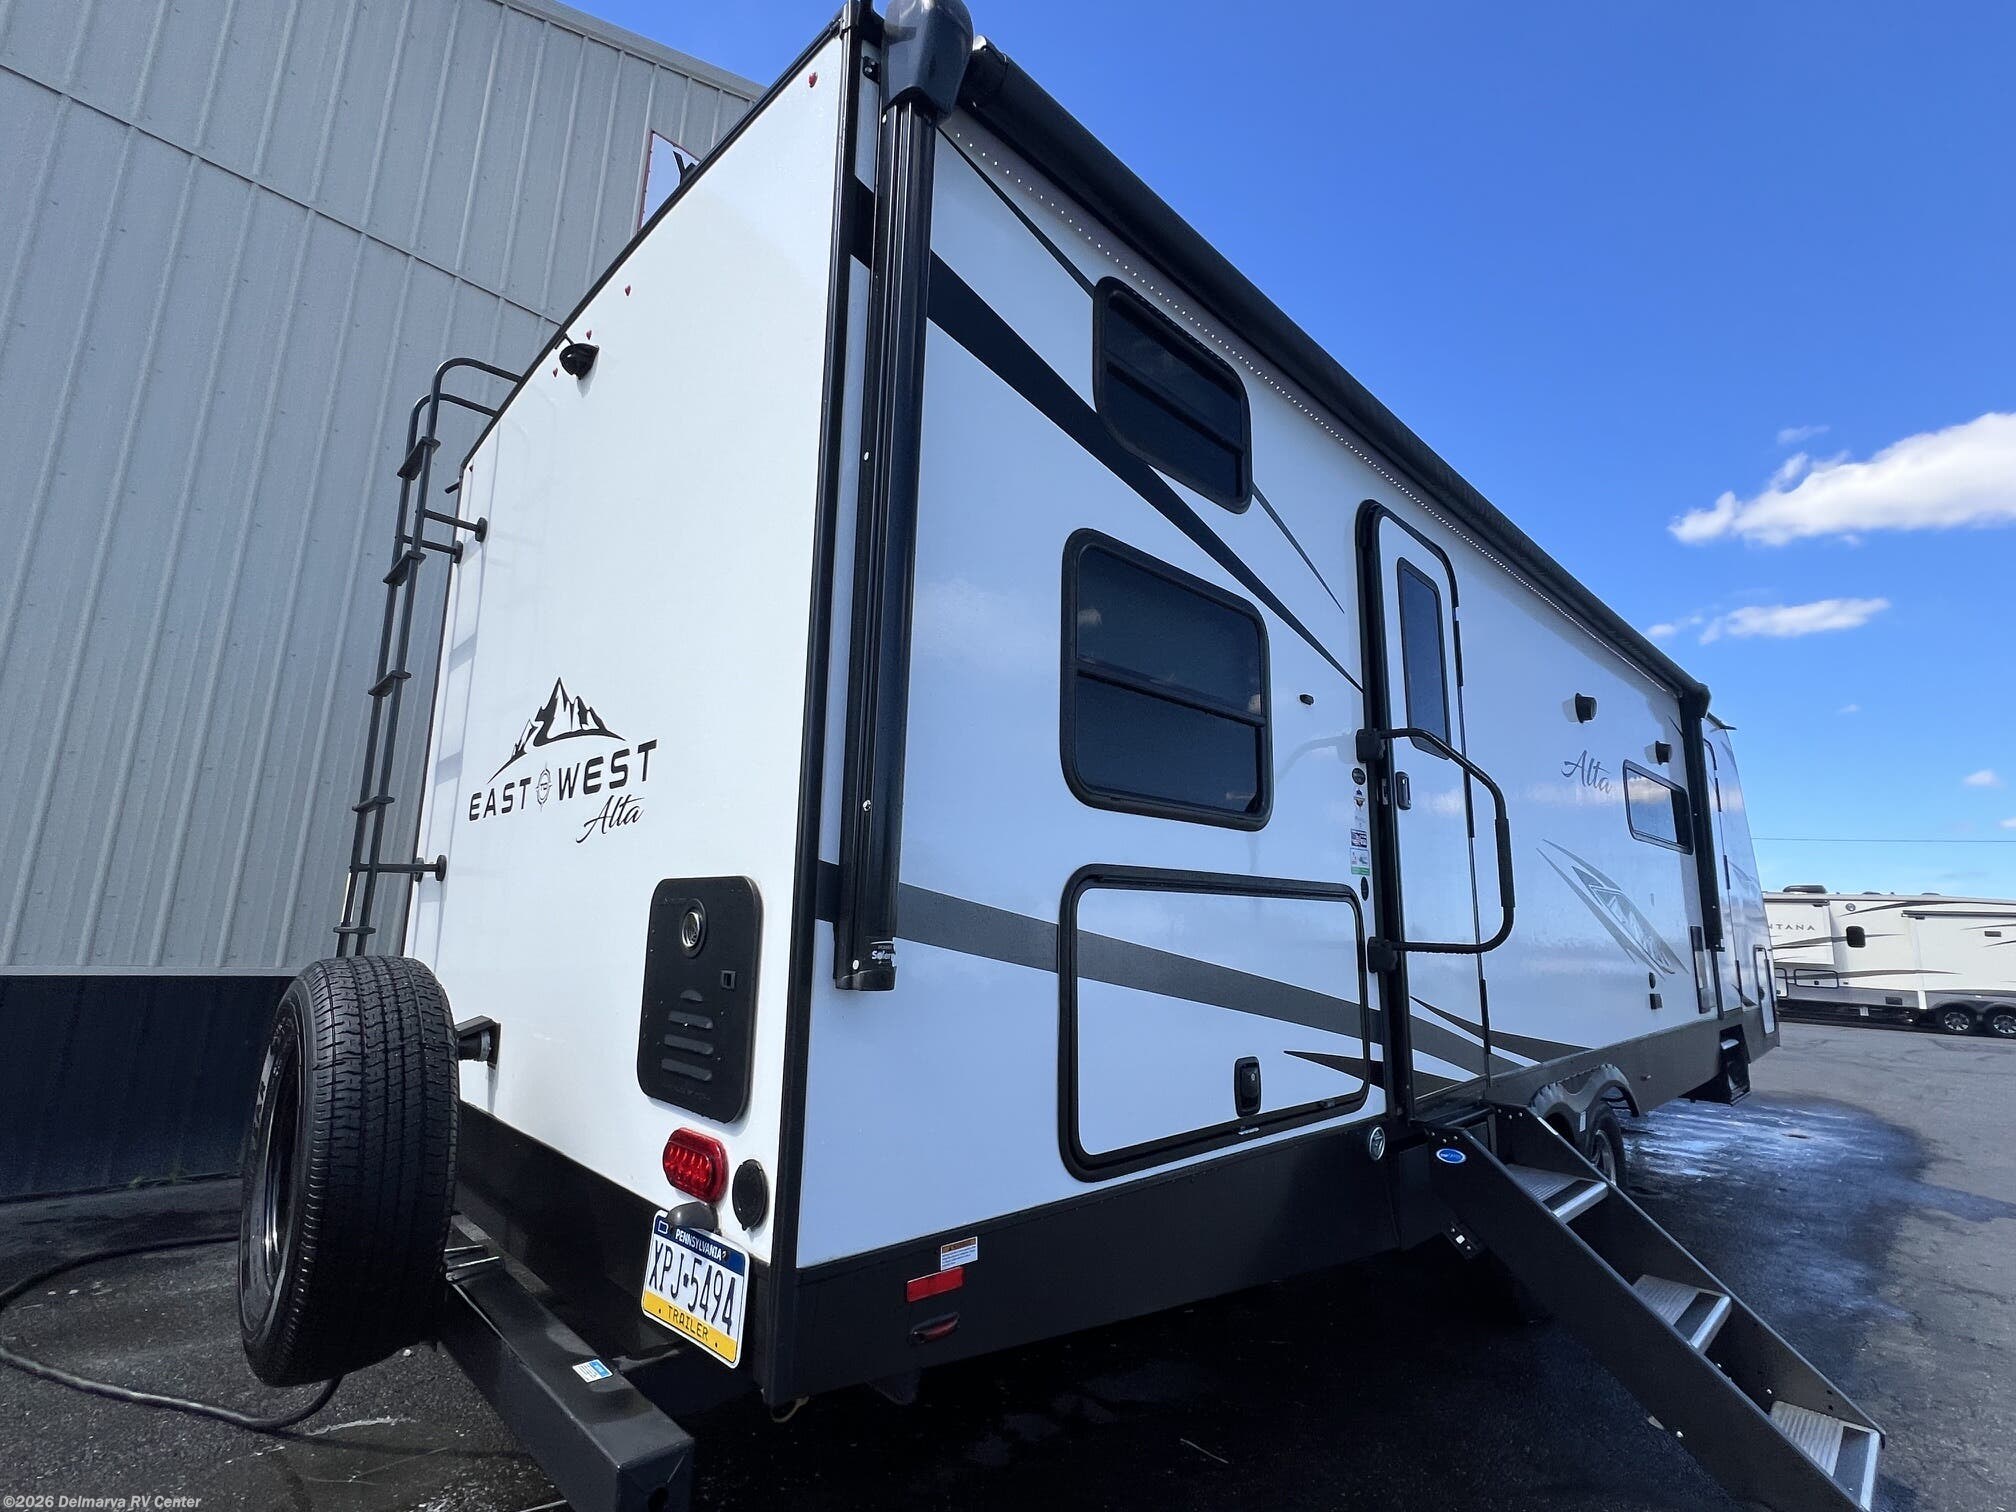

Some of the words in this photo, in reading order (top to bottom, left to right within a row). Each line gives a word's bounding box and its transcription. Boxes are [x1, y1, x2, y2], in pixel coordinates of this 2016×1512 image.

[469, 777, 532, 821] EAST
[558, 739, 658, 801] WEST
[1561, 750, 1612, 794] Alta
[576, 794, 645, 844] Alta
[675, 1229, 723, 1261] PENNSYLVANIA
[667, 1305, 709, 1341] TRAILER
